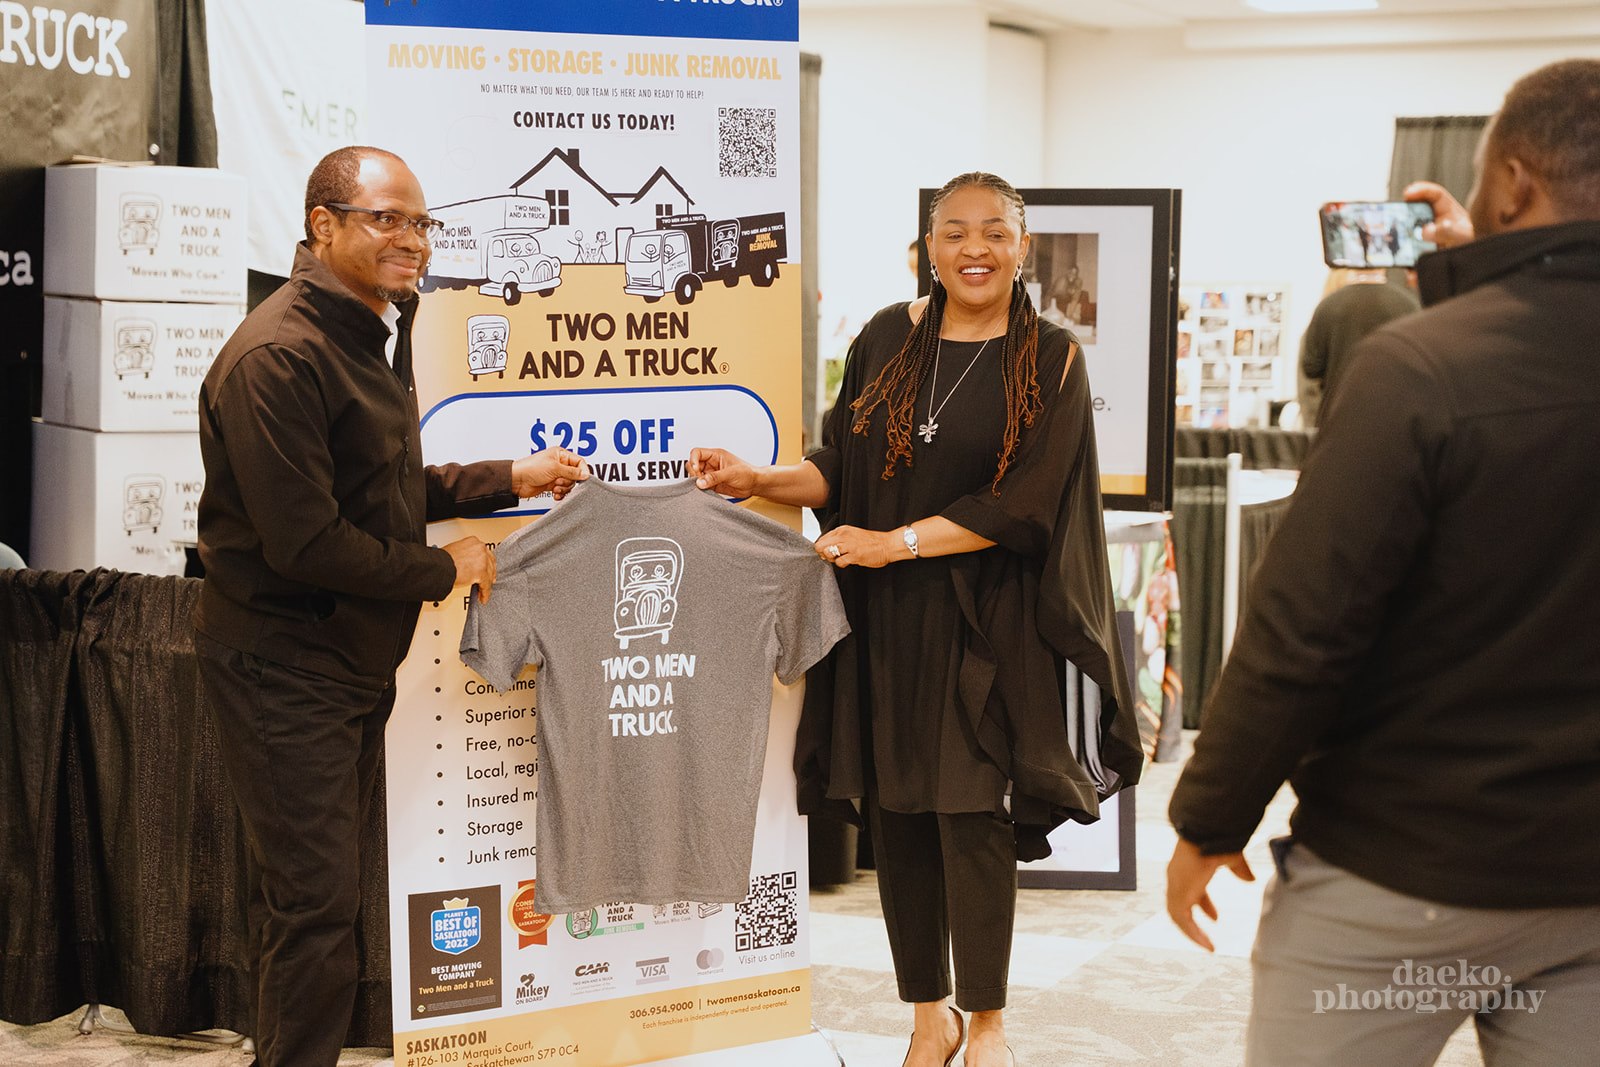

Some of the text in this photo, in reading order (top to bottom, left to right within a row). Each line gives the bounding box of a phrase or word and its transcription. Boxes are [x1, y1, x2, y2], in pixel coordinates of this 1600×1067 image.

[0, 1, 131, 79] RUCK
[388, 44, 782, 80] MOVING STORAGE JUNK REMOVAL
[480, 84, 705, 100] NO MATTER WHAT YOU NEED, OUR TEAM IS HERE AND READY TO HELP!
[513, 110, 676, 131] CONTACT US TODAY!
[171, 204, 231, 220] TWO MEN
[181, 225, 220, 238] AND A
[441, 226, 472, 238] TWO MEN
[434, 240, 449, 249] AND
[450, 240, 456, 249] A
[749, 240, 778, 252] REMOVAL
[165, 328, 224, 340] TWO MEN
[546, 311, 689, 342] TWO MEN
[176, 347, 214, 358] AND A
[518, 350, 585, 380] AND
[594, 349, 617, 378] A
[530, 418, 675, 457] $25 OFF
[601, 653, 696, 682] TWO MEN
[609, 681, 674, 709] AND A
[465, 705, 526, 727] Superior
[466, 737, 501, 752] Free,
[466, 761, 509, 780] Local,
[467, 787, 518, 808] Insured
[467, 820, 523, 836] Storage
[467, 846, 500, 865] Junk
[607, 905, 634, 916] AND A
[607, 913, 633, 923] TRUCK
[434, 915, 478, 932] BEST OF
[434, 928, 478, 941] SASKATOON
[444, 938, 468, 949] 2022
[738, 949, 796, 965] Visit us online
[431, 961, 482, 975] BEST MOVING
[438, 970, 476, 981] COMPANY
[640, 965, 667, 978] VISA
[418, 987, 434, 995] Two
[435, 984, 452, 993] Men
[453, 981, 468, 991] and
[475, 977, 495, 988] Truck
[516, 985, 550, 999] Mikey
[525, 996, 544, 1004] BOARD
[629, 985, 801, 1020] 306.954.9000 twomensaskatoon.ca
[642, 1021, 657, 1030] Each
[658, 1017, 684, 1027] franchise
[690, 1009, 730, 1022] independently
[730, 1006, 750, 1015] owned
[750, 1003, 761, 1012] and
[406, 1030, 488, 1055] SASKATOON
[407, 1040, 534, 1067] #126-103 Marquis Court,
[537, 1048, 556, 1061] S7P
